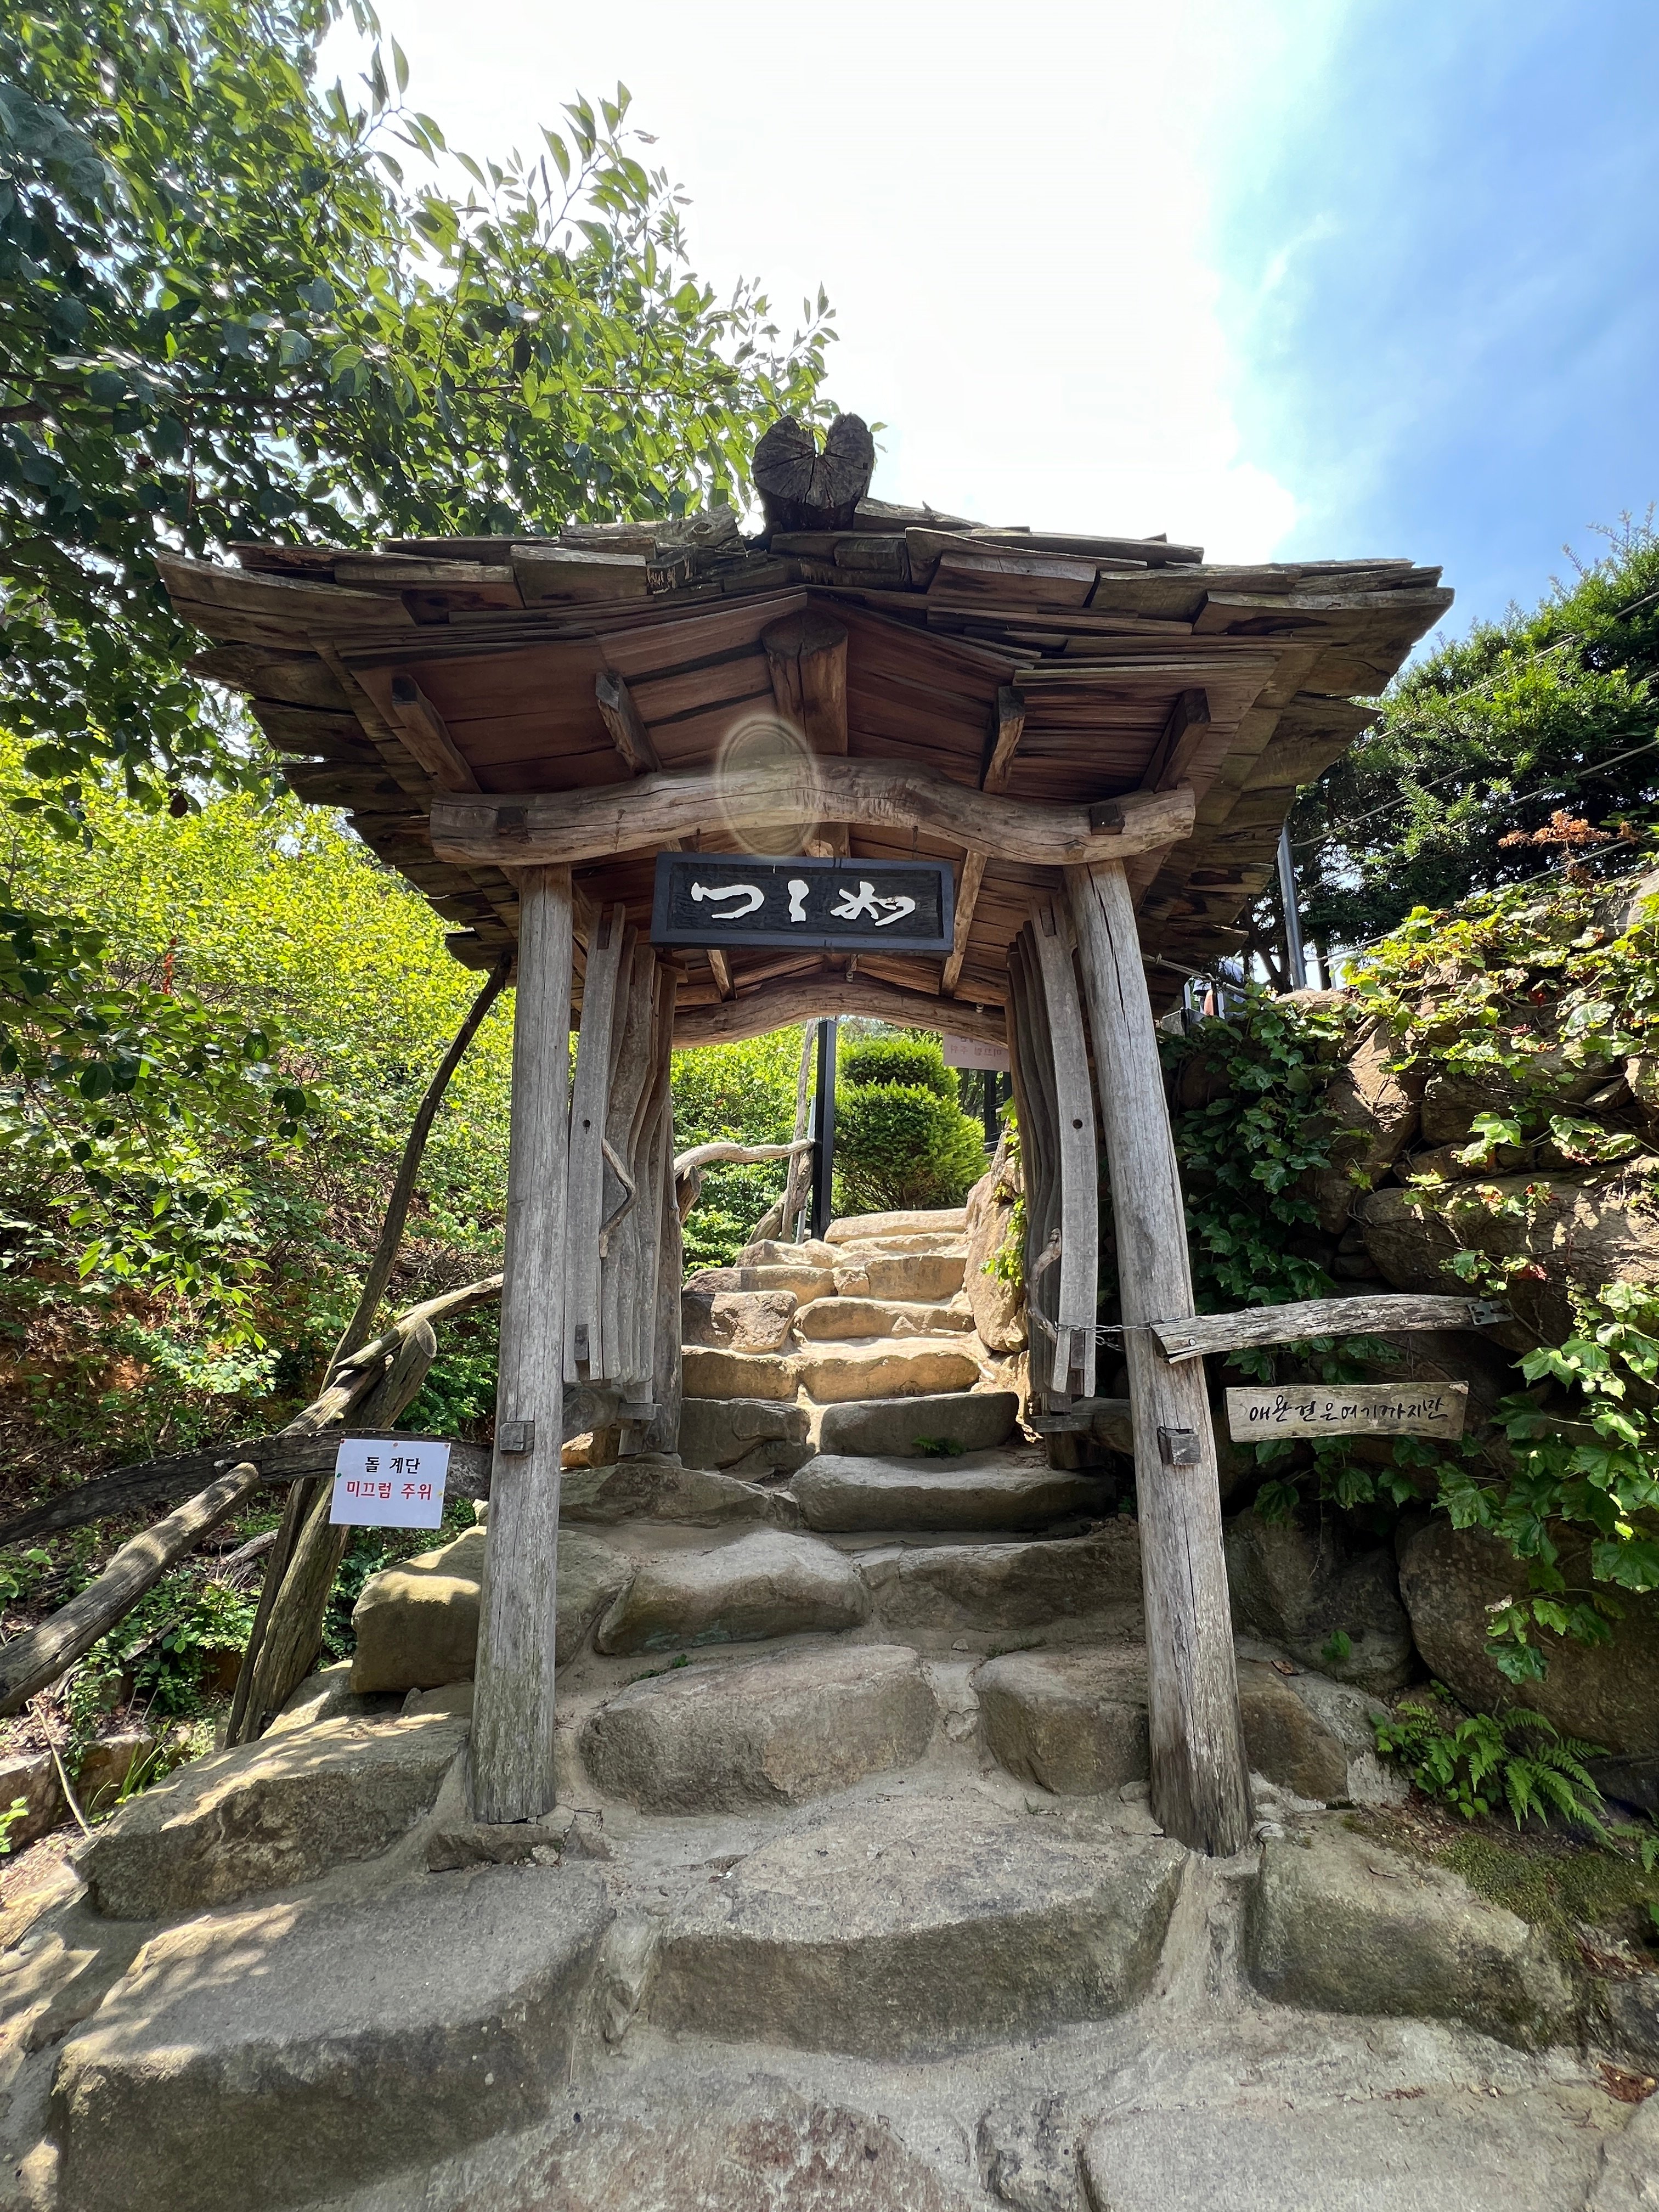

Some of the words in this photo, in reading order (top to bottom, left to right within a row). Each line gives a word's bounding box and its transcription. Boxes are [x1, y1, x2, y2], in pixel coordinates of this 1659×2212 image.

[365, 1457, 380, 1472] 돌
[389, 1457, 421, 1474] 계단
[347, 1481, 392, 1499] 미끄럼
[400, 1483, 432, 1500] 주위
